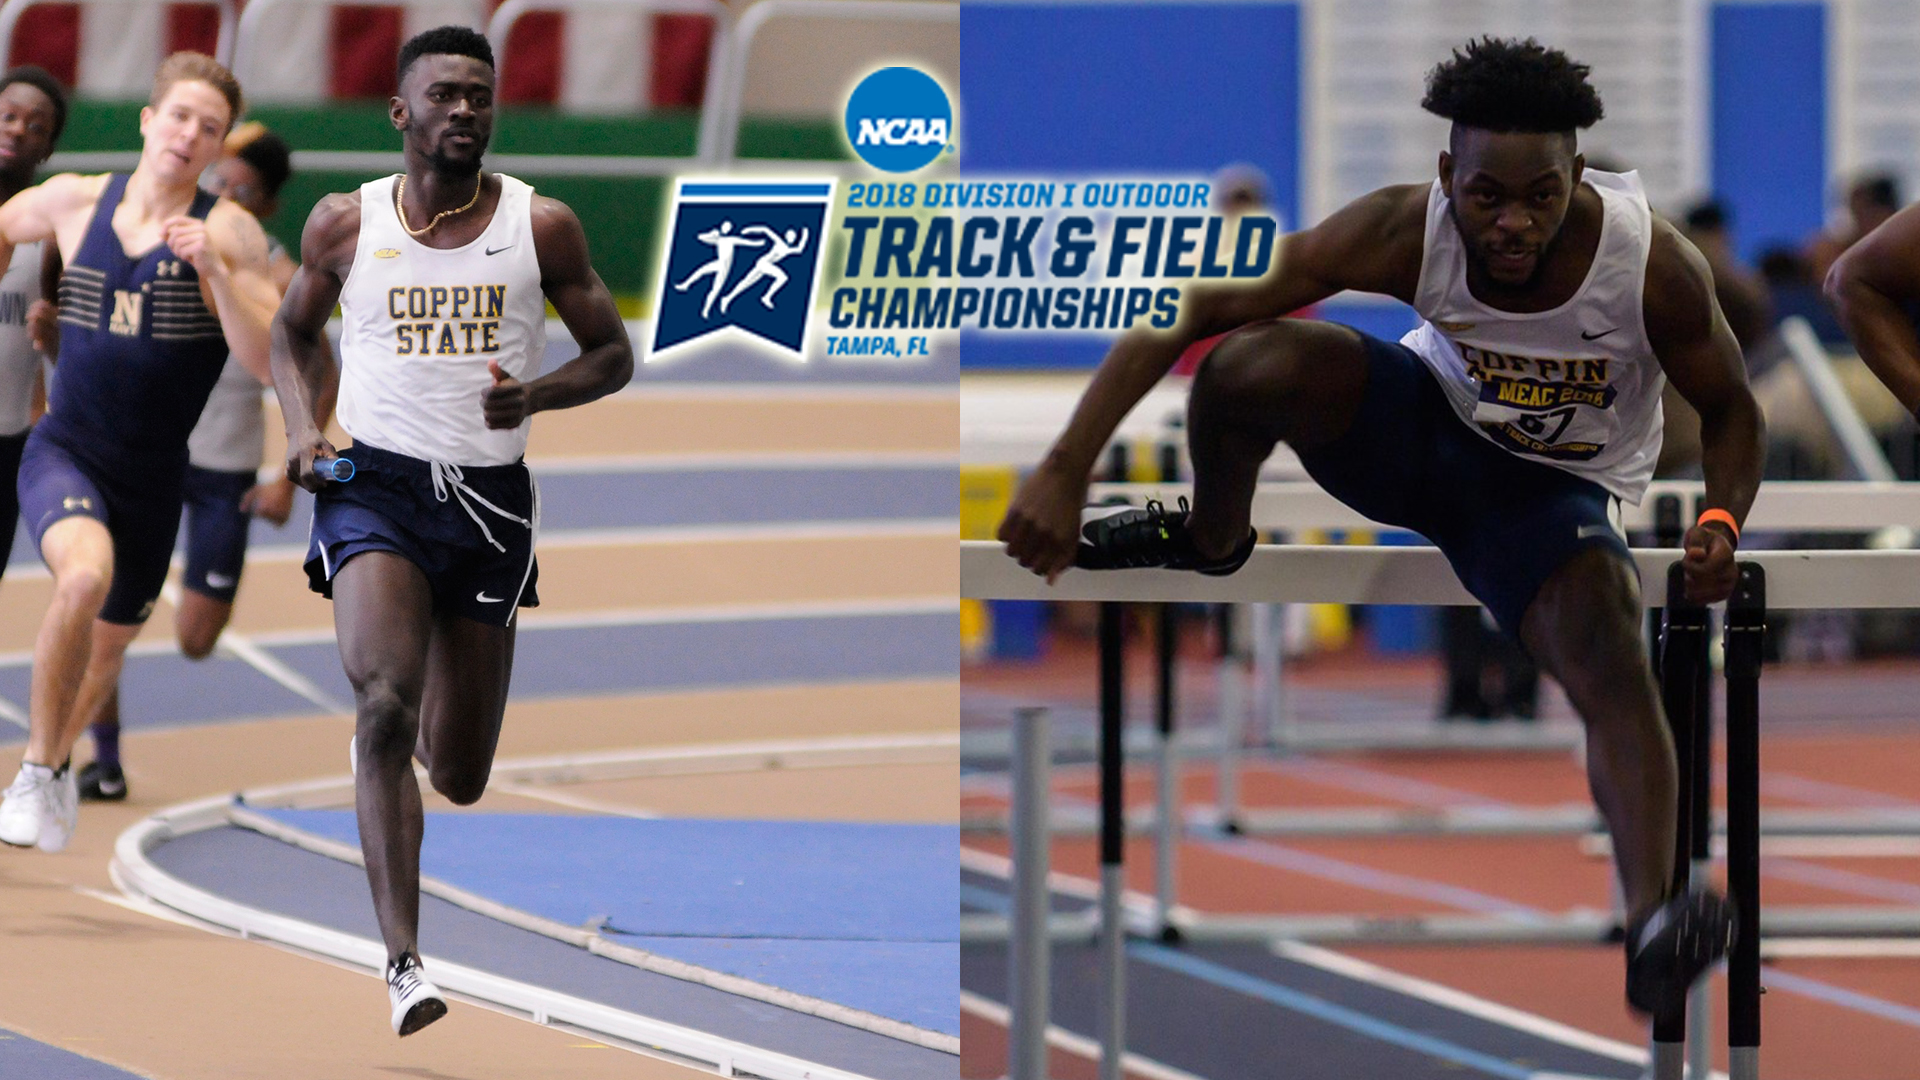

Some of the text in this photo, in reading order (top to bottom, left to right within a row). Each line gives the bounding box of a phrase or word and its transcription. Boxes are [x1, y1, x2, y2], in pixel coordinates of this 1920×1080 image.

[387, 284, 508, 320] COPPIN
[395, 320, 501, 356] STATE
[1498, 381, 1606, 407] MEAC 2018
